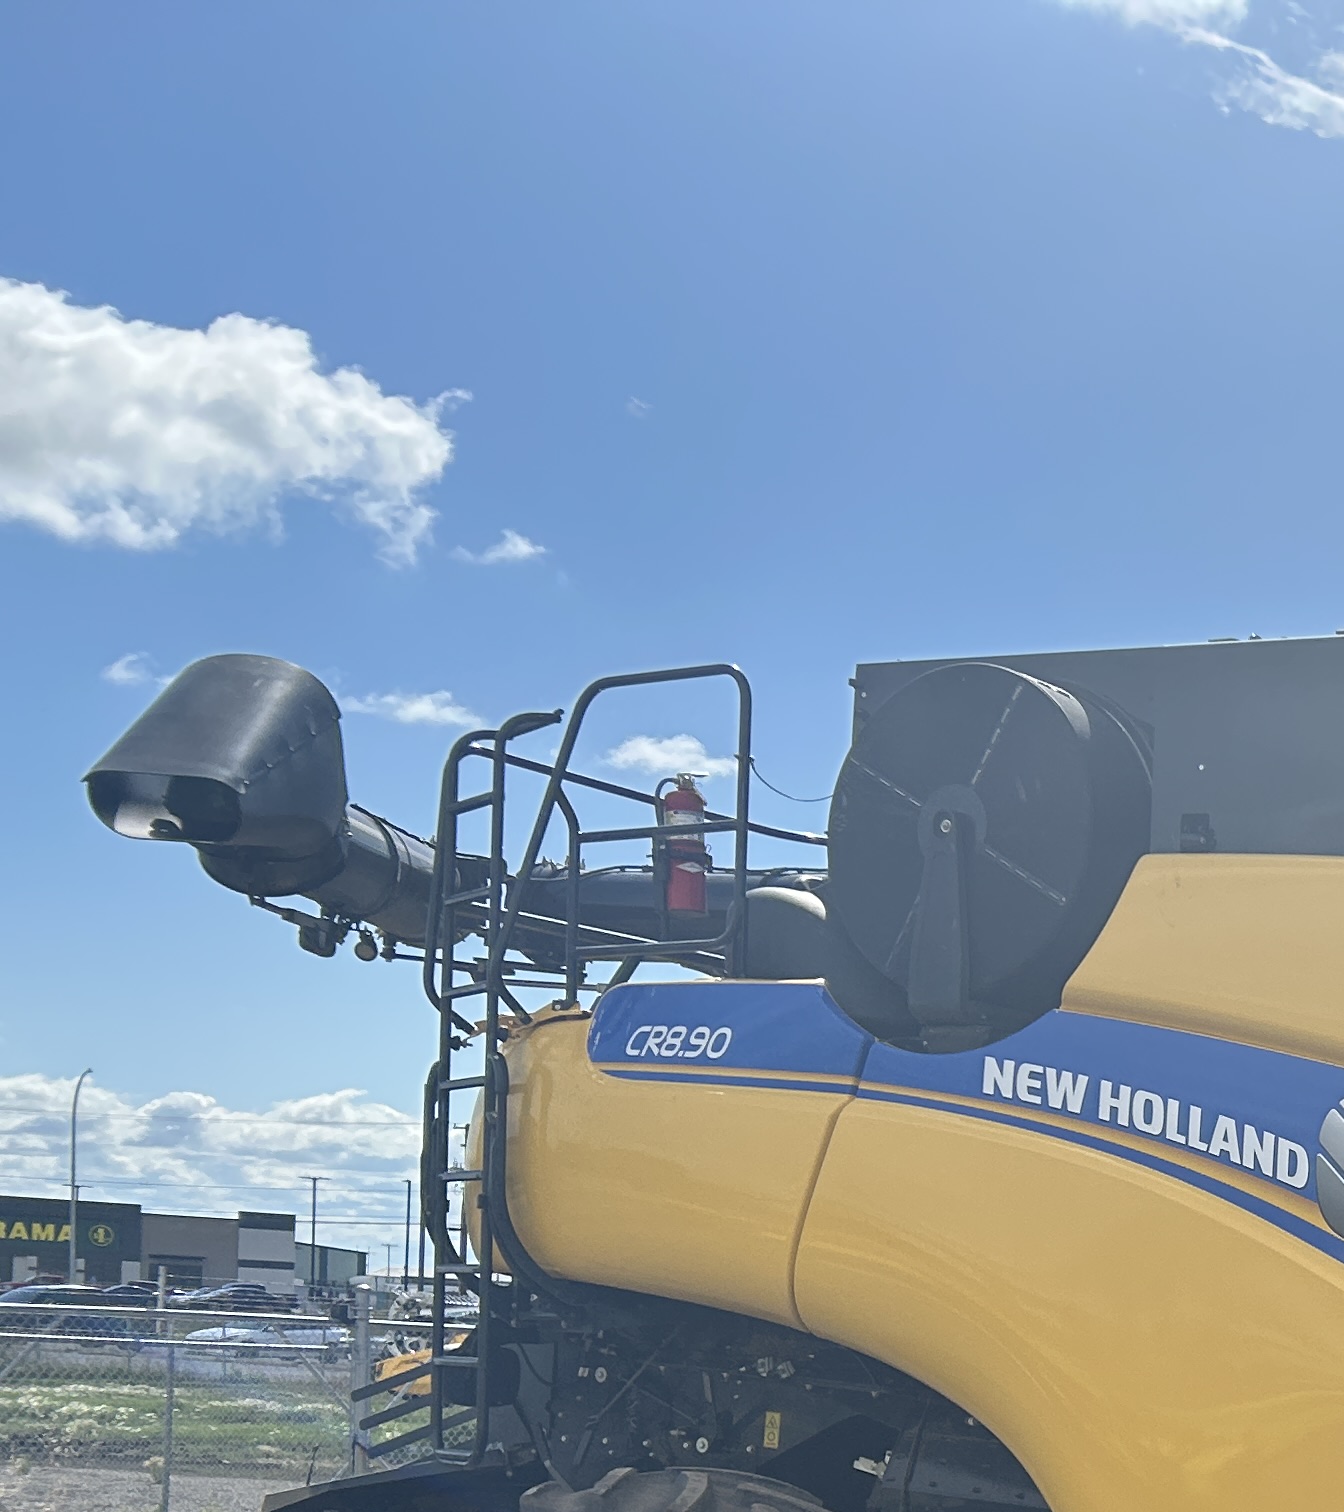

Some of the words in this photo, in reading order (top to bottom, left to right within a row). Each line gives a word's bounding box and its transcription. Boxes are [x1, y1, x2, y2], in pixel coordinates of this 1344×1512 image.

[625, 1025, 732, 1059] CR8.90
[982, 1056, 1089, 1114] NEW
[1098, 1080, 1309, 1188] HOLLAND
